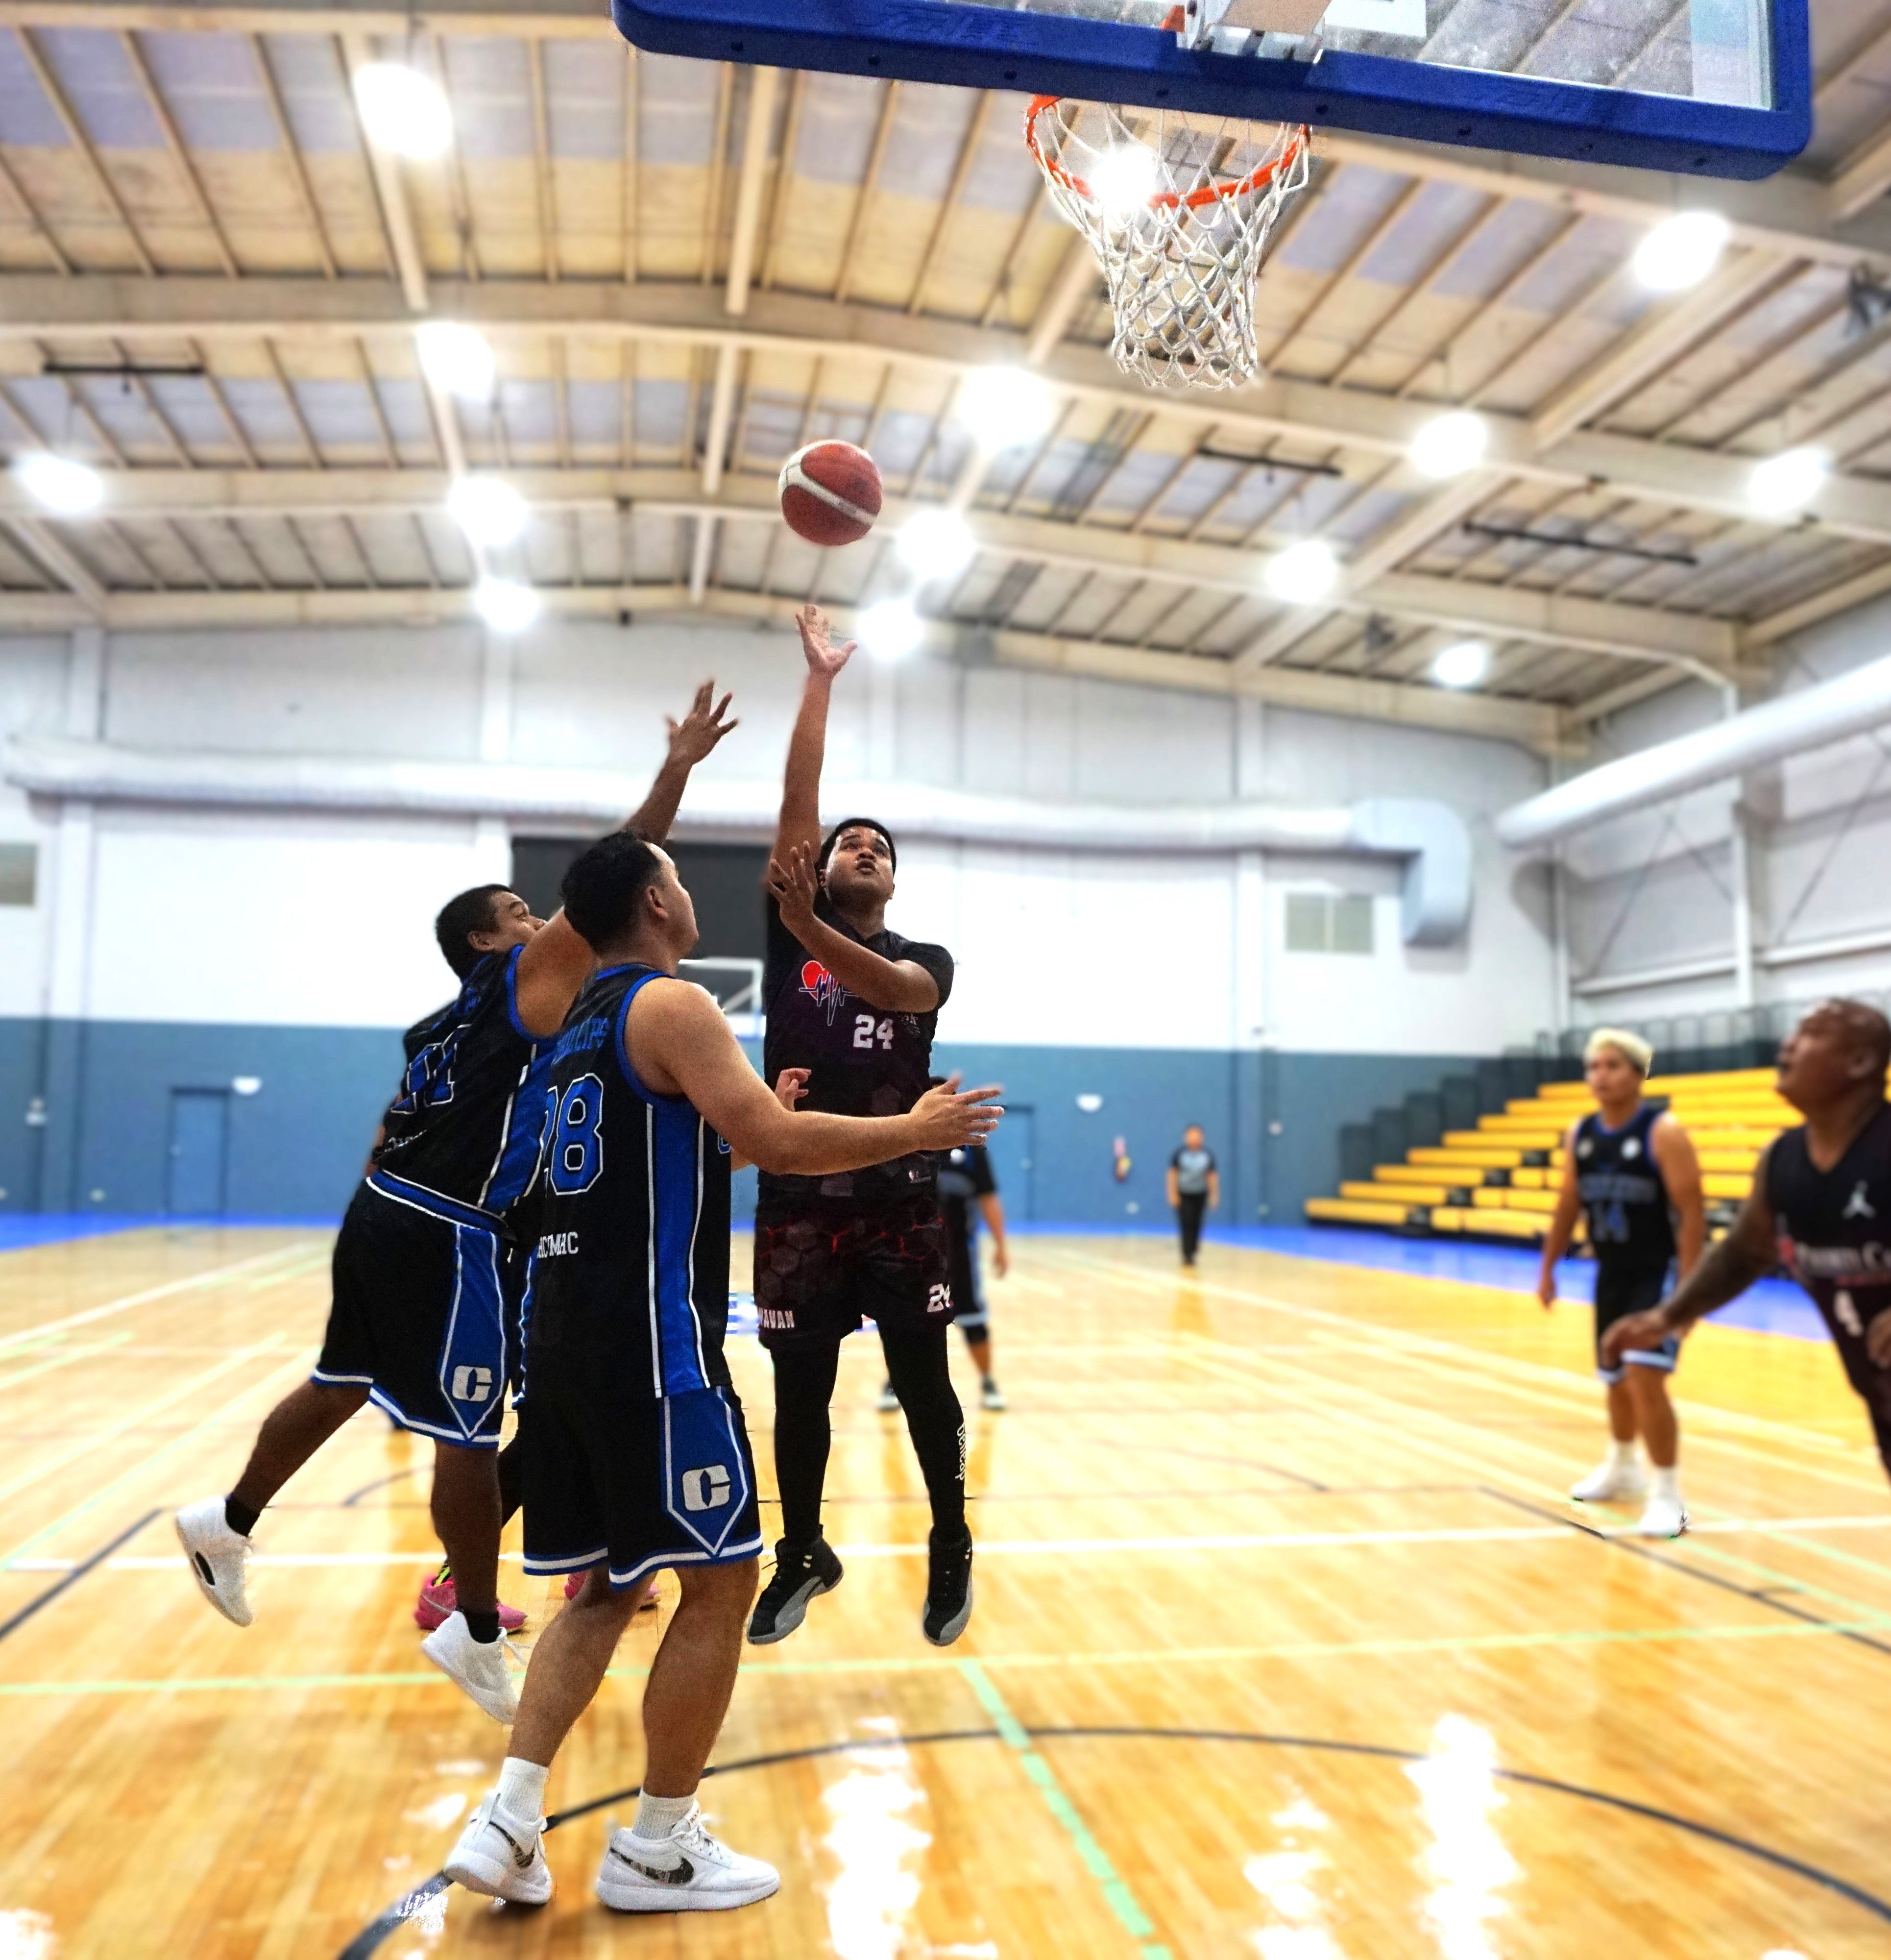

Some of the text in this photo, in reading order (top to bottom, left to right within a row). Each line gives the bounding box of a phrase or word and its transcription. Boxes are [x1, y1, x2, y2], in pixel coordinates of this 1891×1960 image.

[852, 1014, 894, 1050] 24
[452, 1365, 493, 1402] C
[681, 1464, 732, 1511] C
